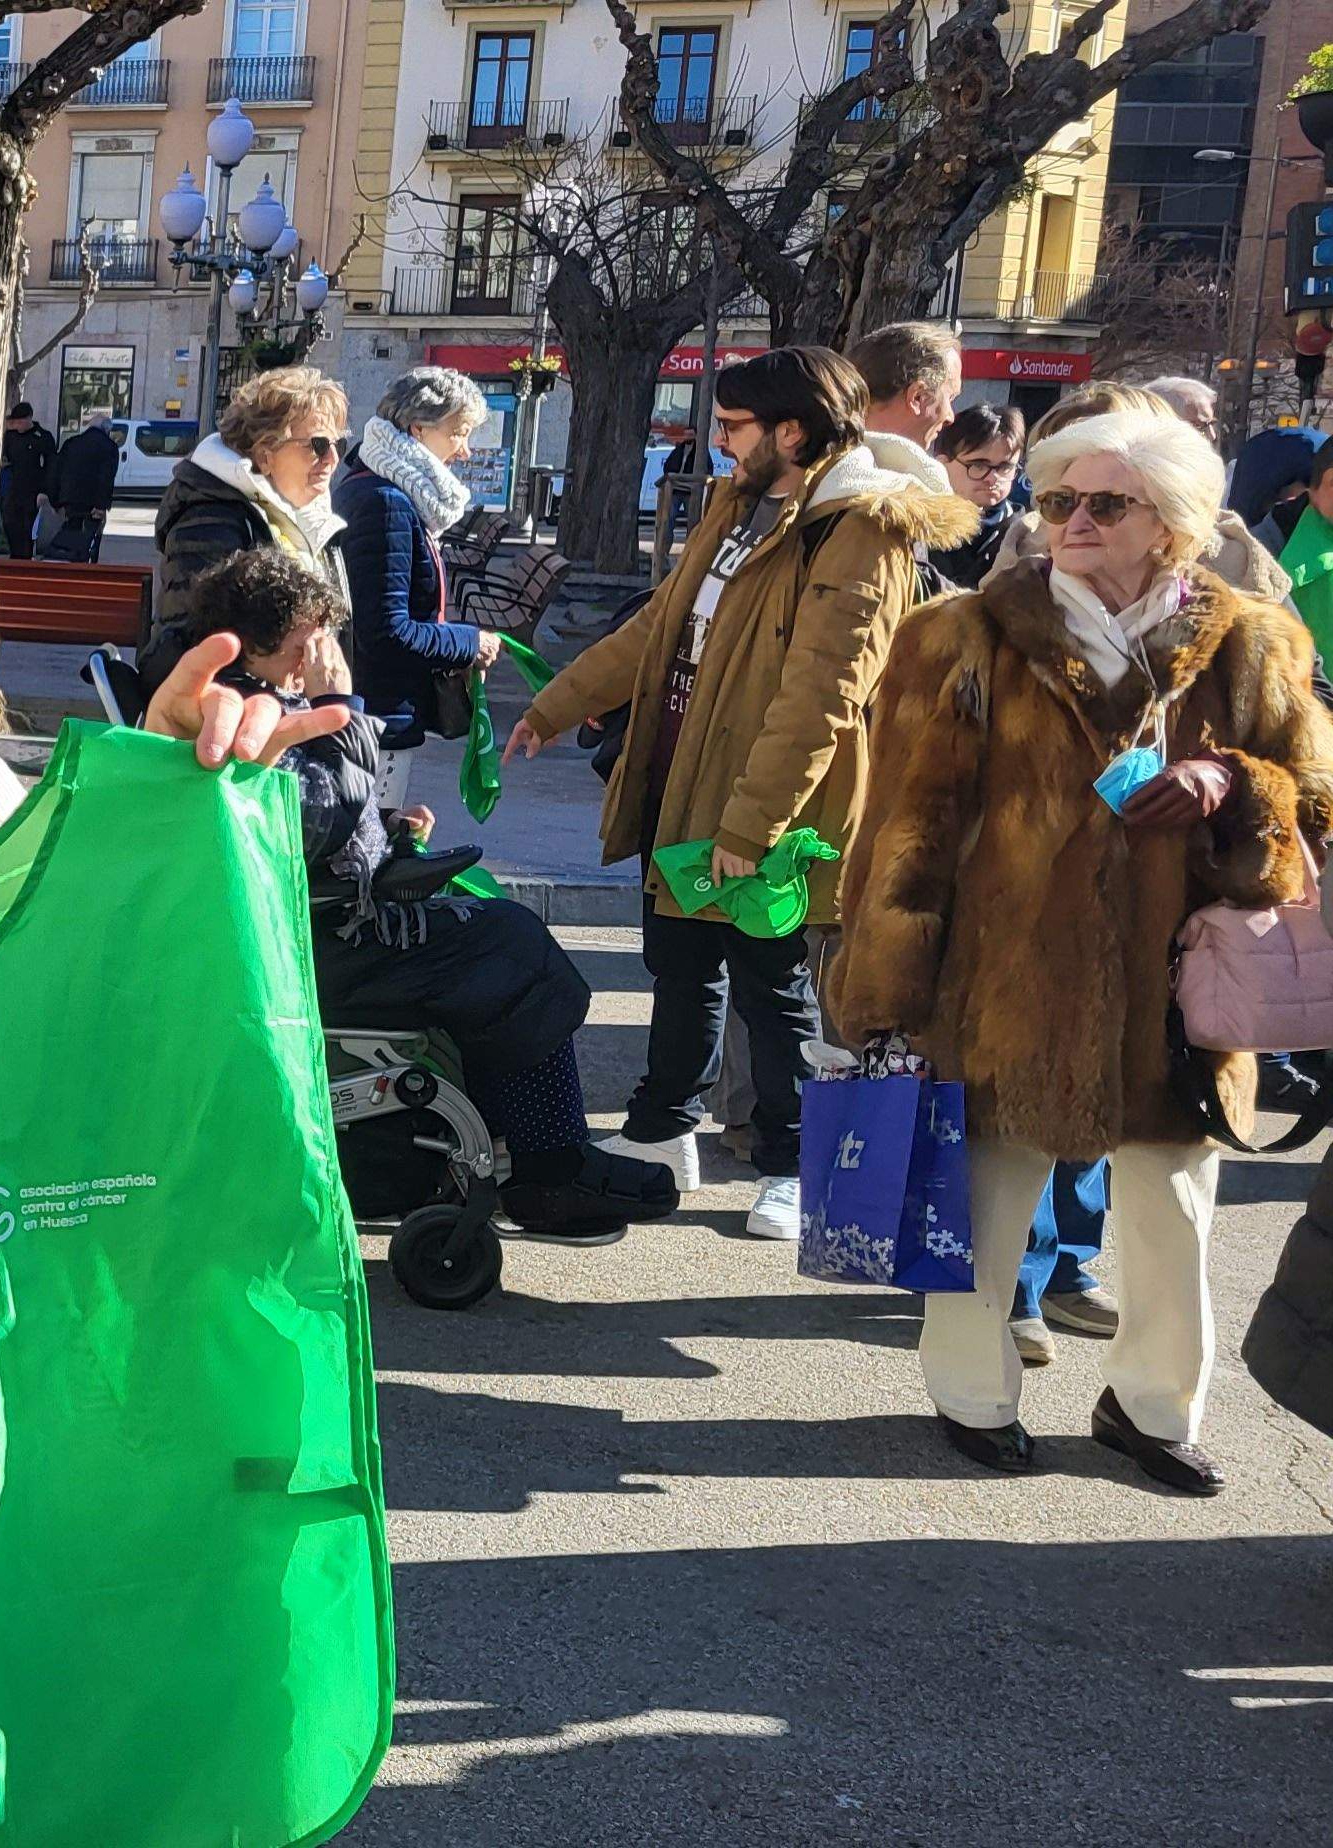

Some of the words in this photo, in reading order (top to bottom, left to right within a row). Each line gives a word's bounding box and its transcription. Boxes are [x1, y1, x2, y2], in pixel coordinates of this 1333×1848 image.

[1023, 359, 1074, 376] Santander
[20, 1181, 89, 1198] asociación
[91, 1174, 157, 1191] española
[21, 1199, 65, 1214] contra
[68, 1198, 79, 1211] el
[80, 1193, 127, 1207] cáncer
[23, 1219, 37, 1231] en
[40, 1213, 88, 1228] Huesca
